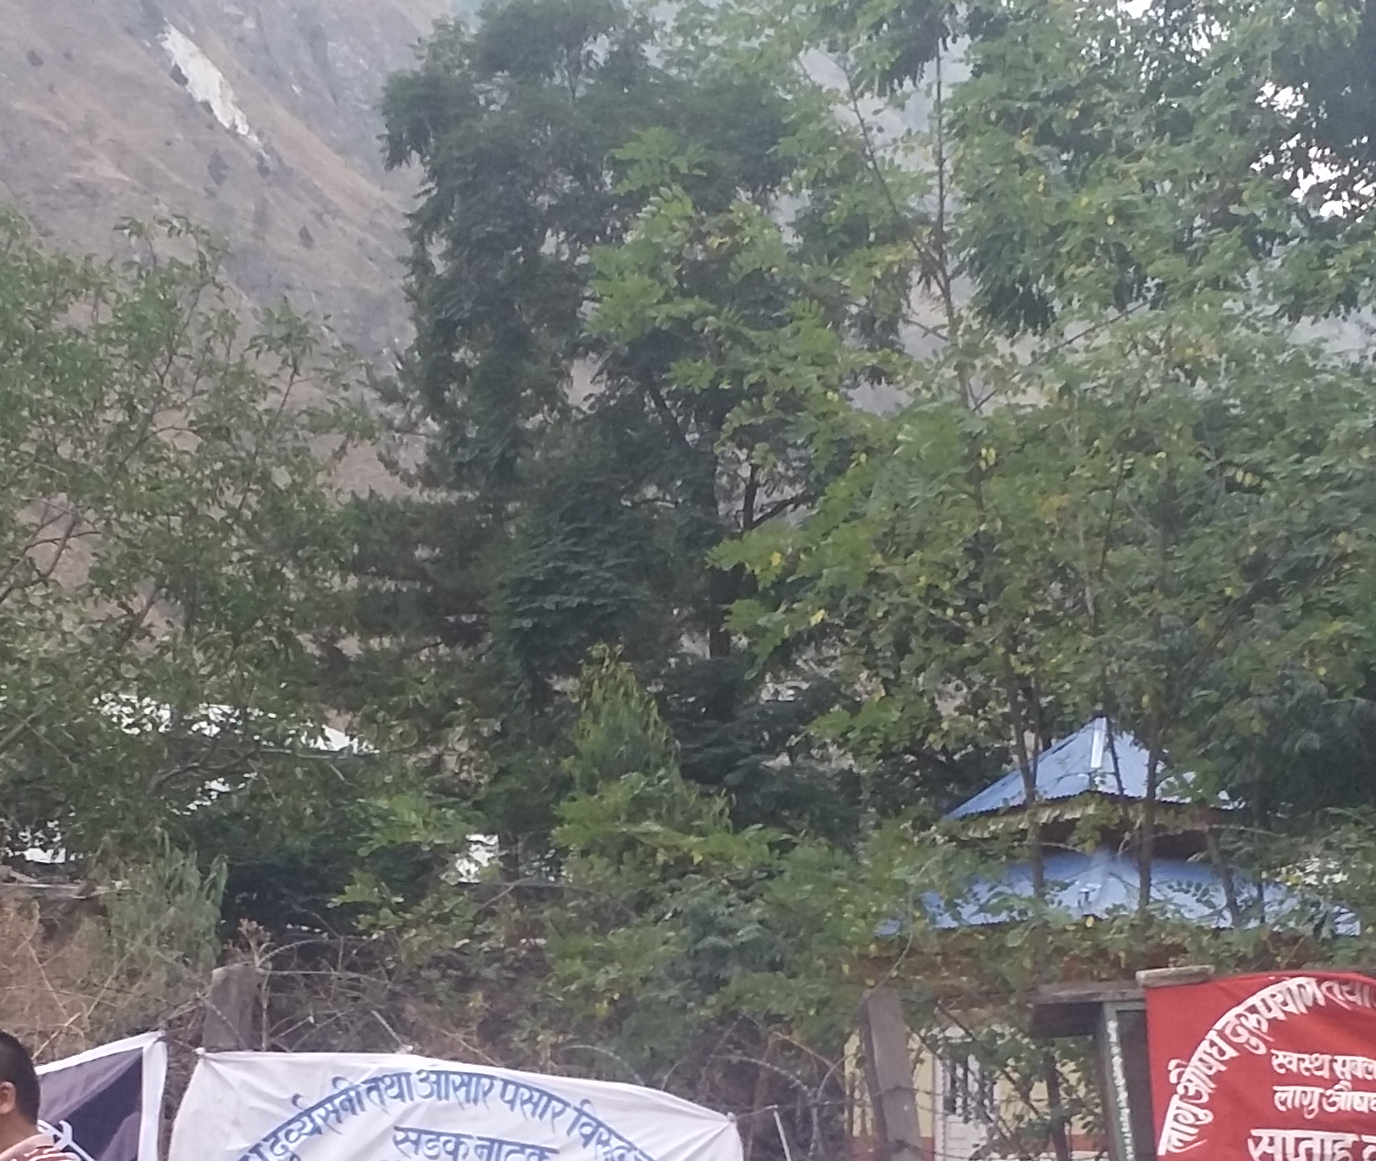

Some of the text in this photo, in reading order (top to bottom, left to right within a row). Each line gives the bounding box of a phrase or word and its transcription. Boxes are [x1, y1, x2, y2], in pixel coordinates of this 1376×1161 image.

[1271, 1049, 1330, 1079] स्वस्थ
[362, 1072, 415, 1115] तथा
[1273, 1085, 1324, 1119] लागु
[1157, 1094, 1214, 1156] लागु
